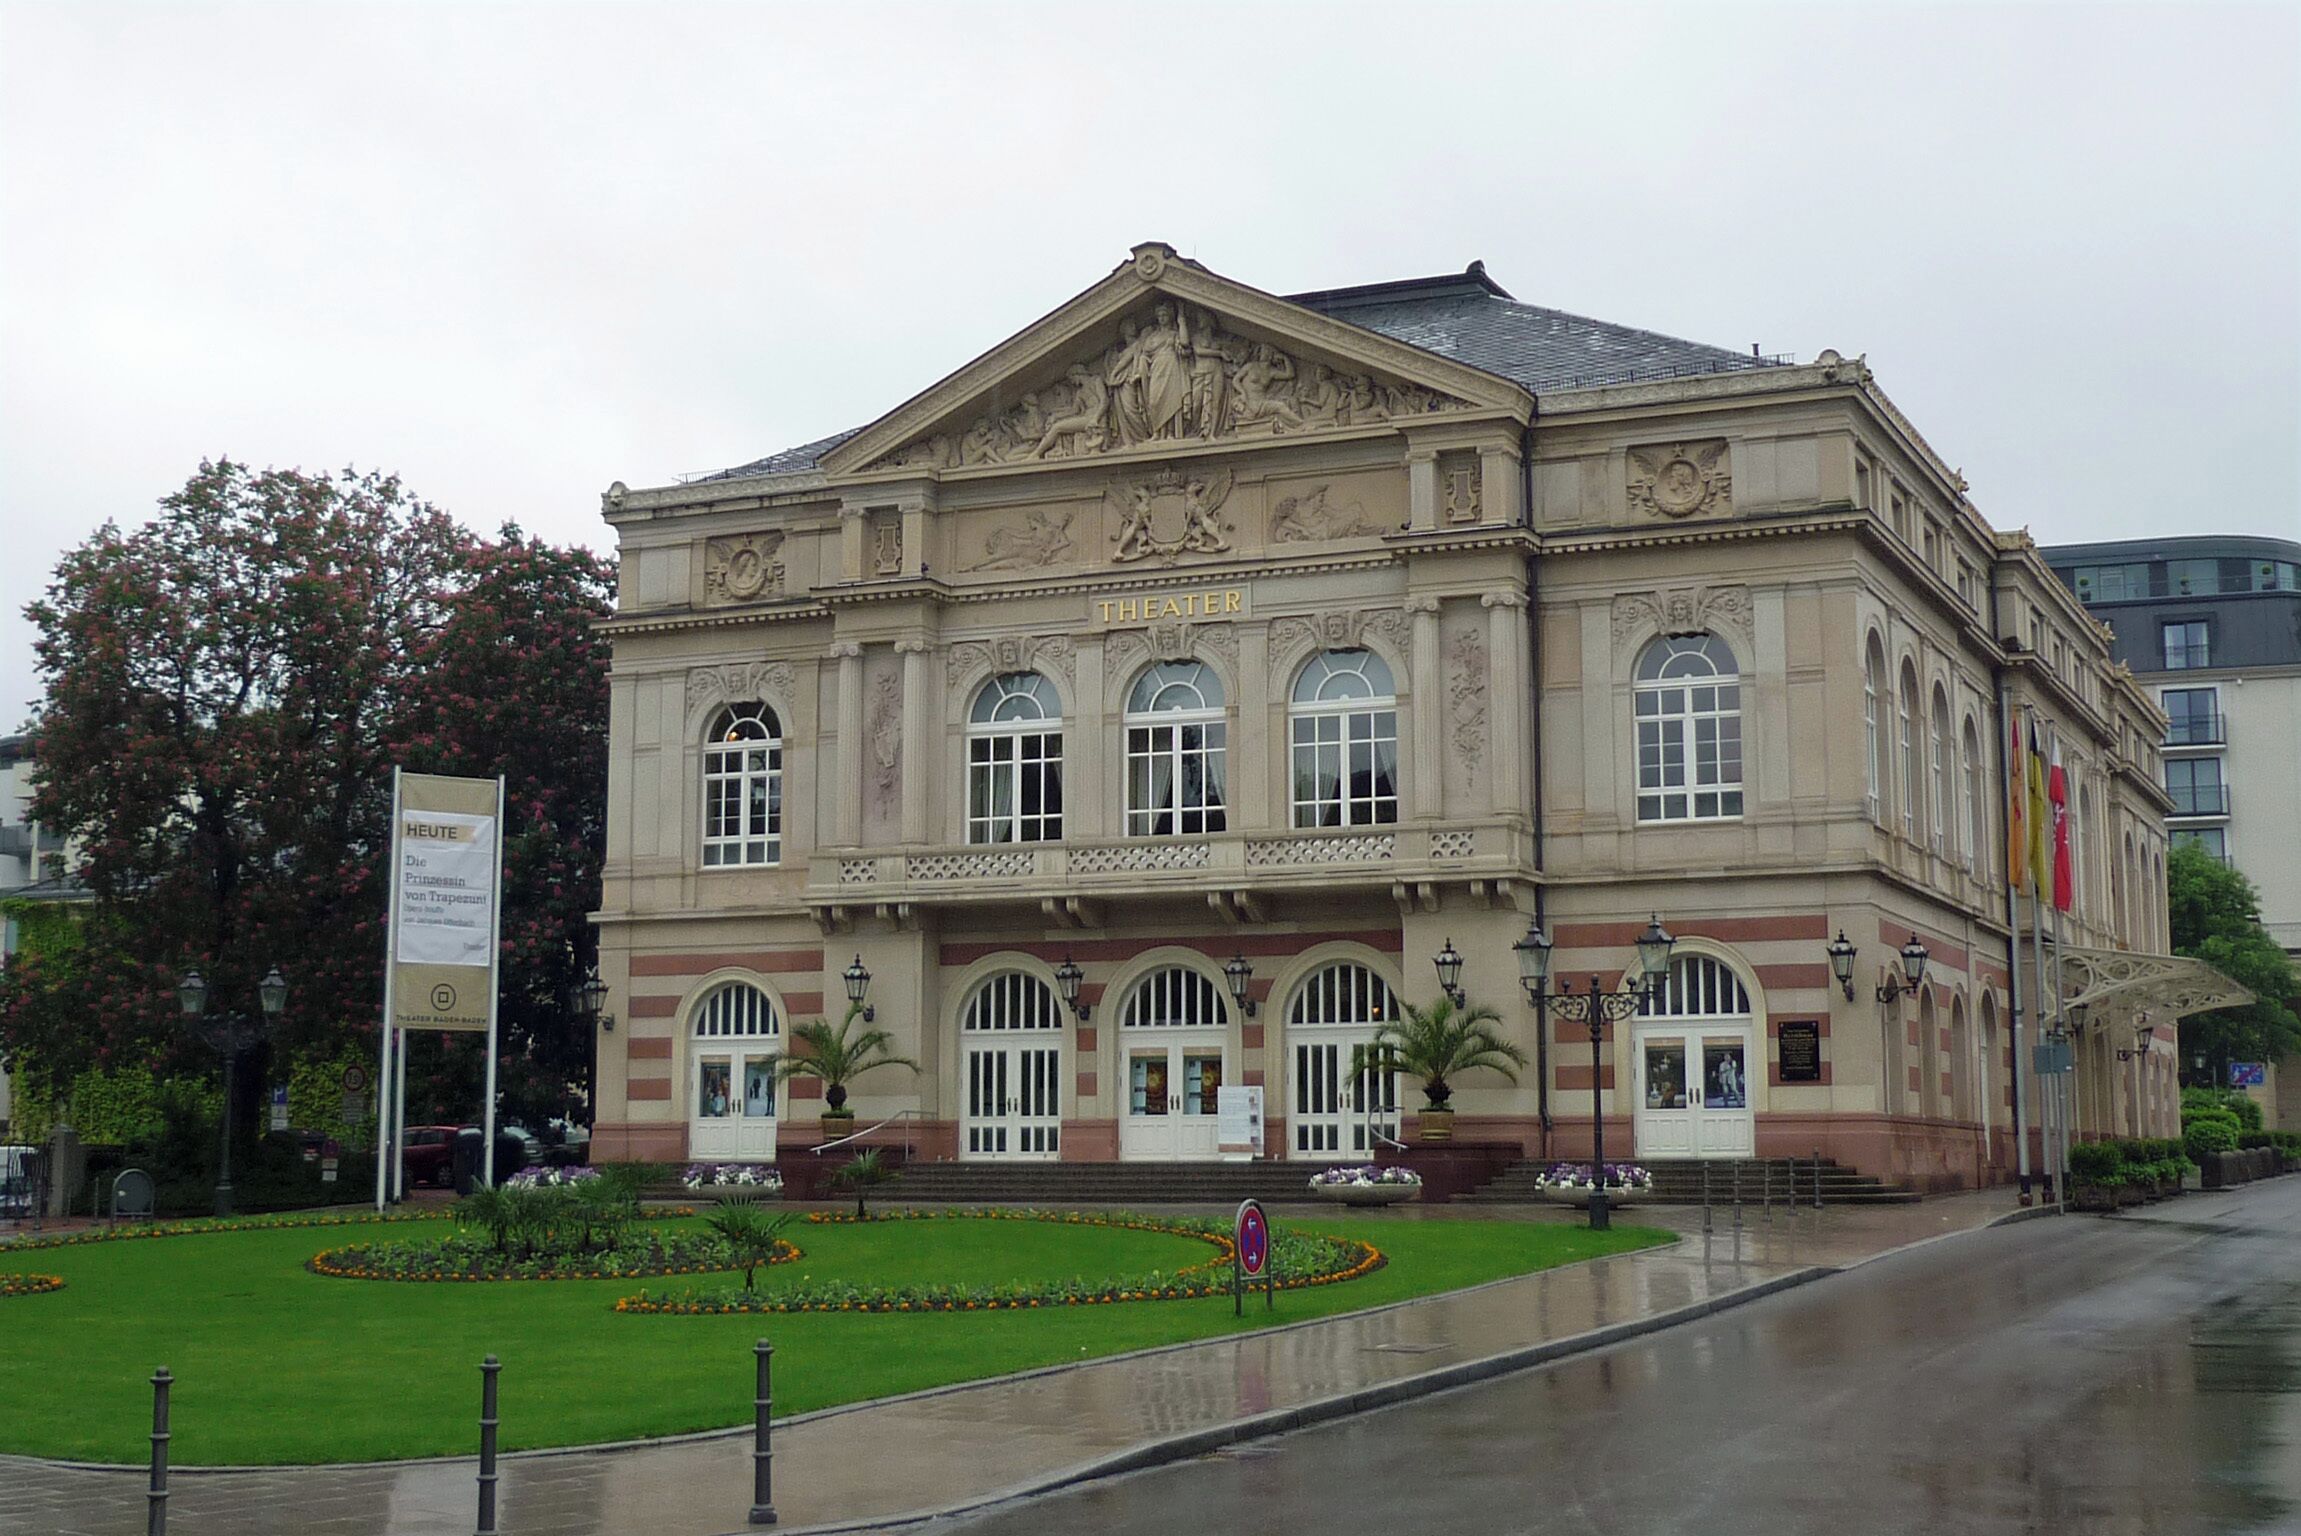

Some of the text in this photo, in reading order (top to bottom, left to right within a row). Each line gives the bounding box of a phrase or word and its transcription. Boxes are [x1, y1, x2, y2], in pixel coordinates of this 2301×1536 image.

[1098, 591, 1242, 623] THEATER
[406, 823, 458, 839] HEUTE
[405, 855, 427, 868] Die
[405, 871, 466, 887] Prinzessin
[404, 890, 487, 905] von Trapezunt
